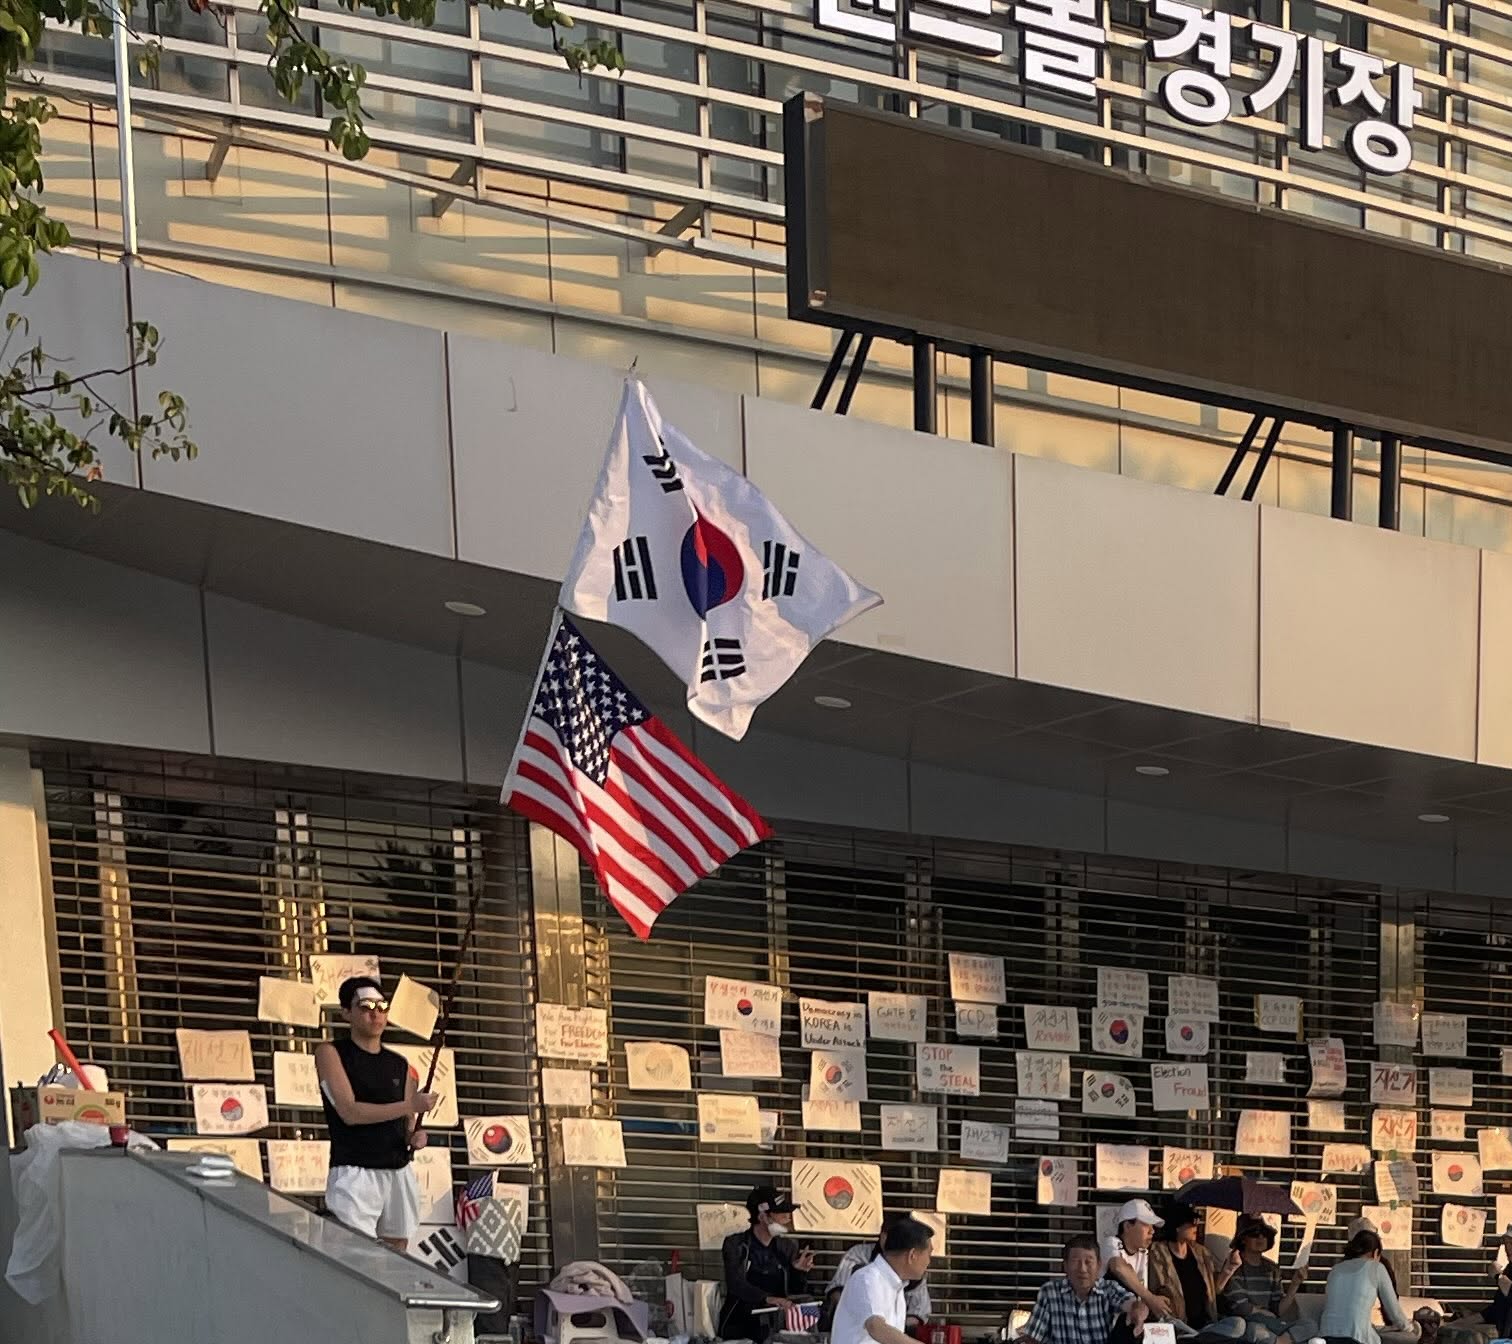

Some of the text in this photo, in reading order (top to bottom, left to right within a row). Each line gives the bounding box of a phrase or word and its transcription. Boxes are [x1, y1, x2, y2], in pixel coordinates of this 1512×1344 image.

[1146, 0, 1422, 176] 경기장
[802, 1003, 850, 1019] Democracy
[804, 1017, 840, 1031] KOREA
[805, 1034, 831, 1045] Under
[921, 1047, 953, 1061] STOP
[1153, 1066, 1191, 1078] Election
[939, 1074, 976, 1088] STEAL
[1174, 1082, 1207, 1097] Fraud
